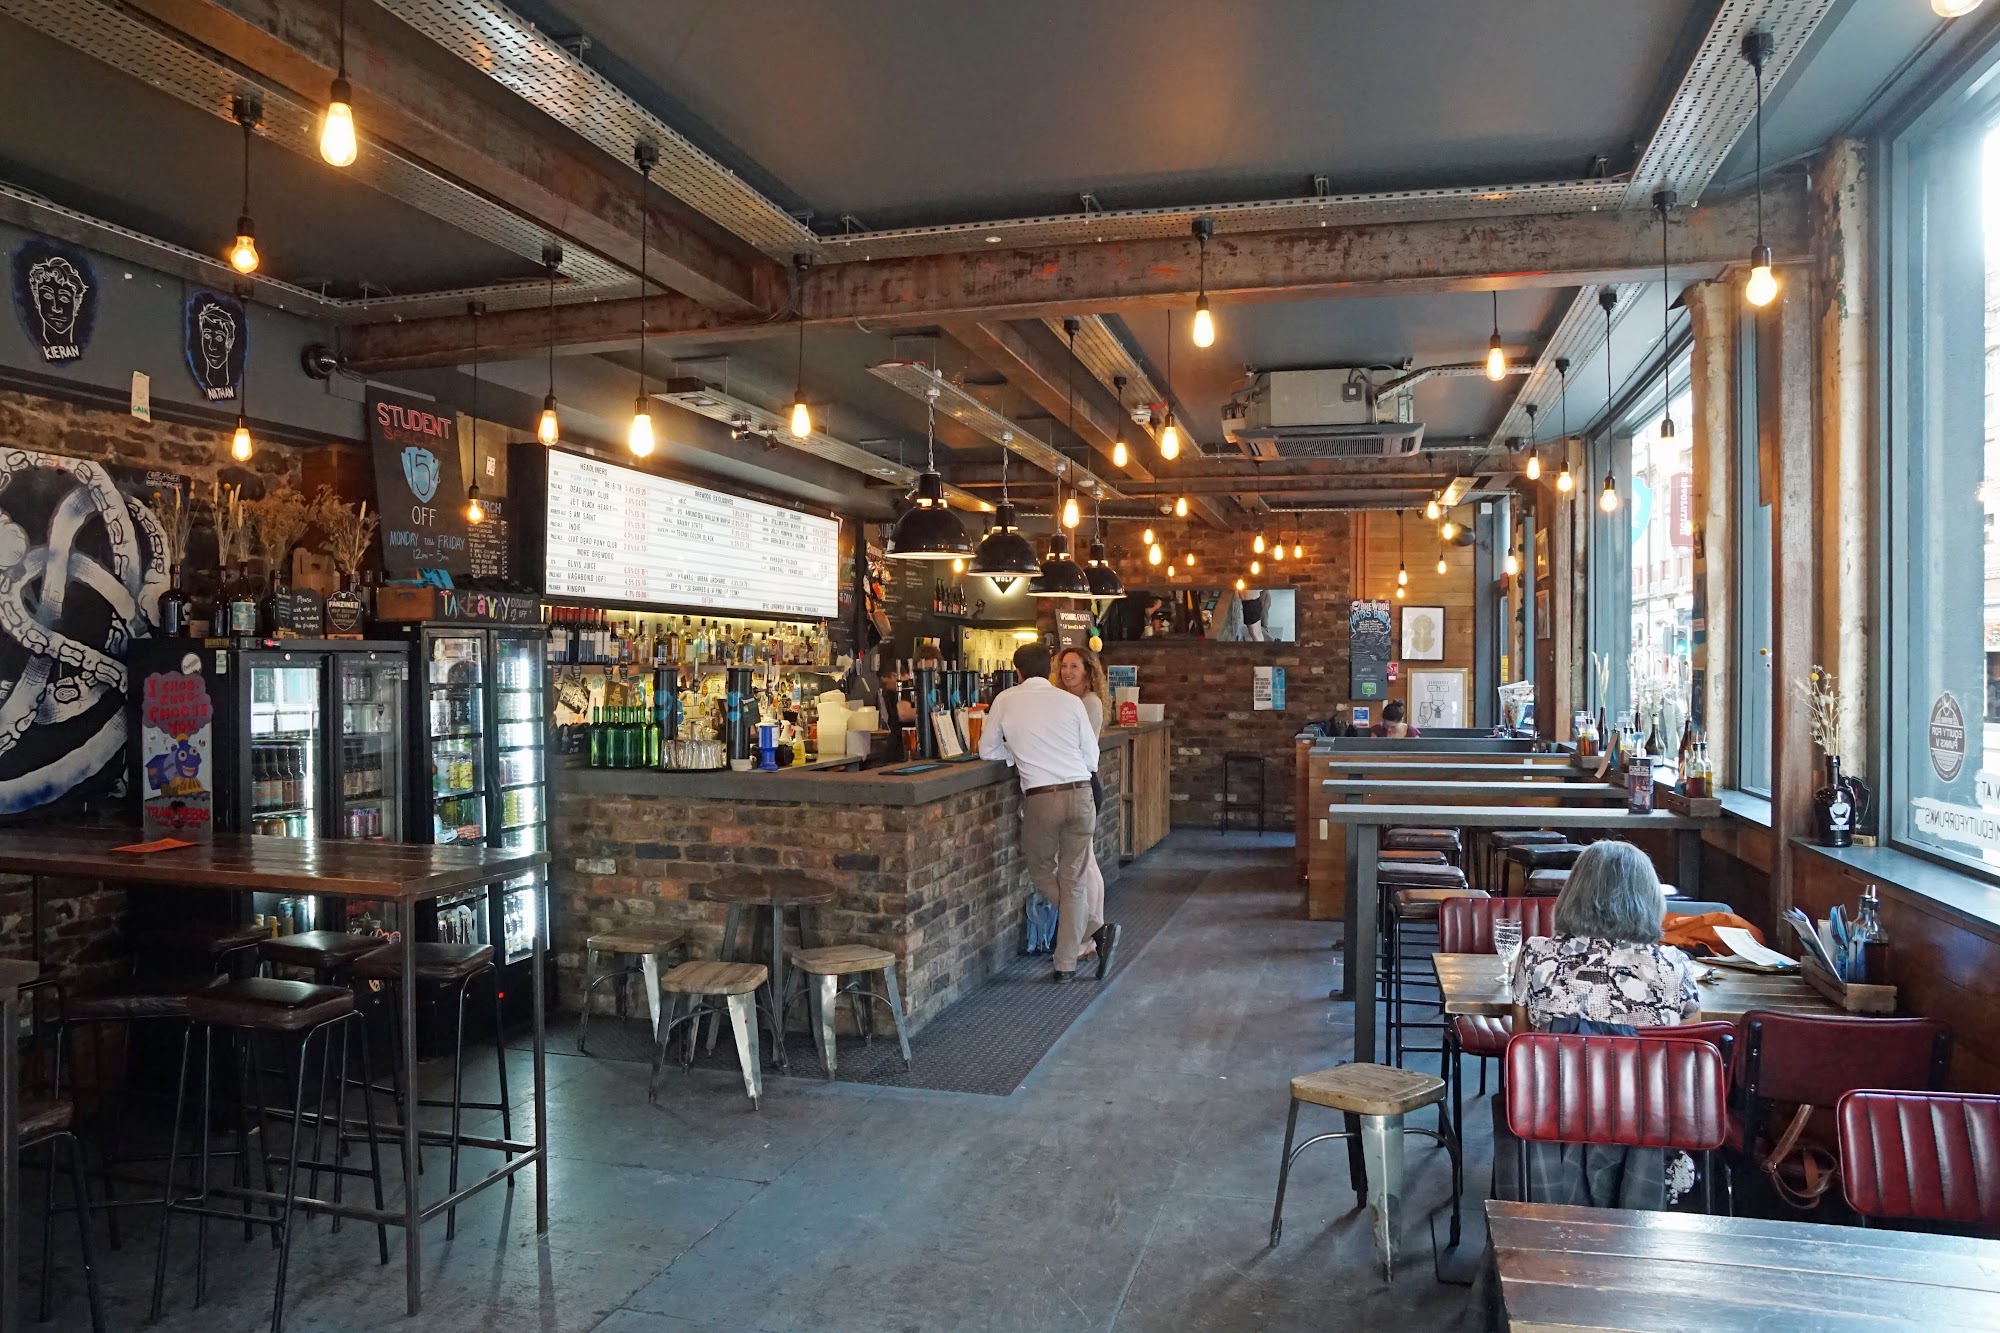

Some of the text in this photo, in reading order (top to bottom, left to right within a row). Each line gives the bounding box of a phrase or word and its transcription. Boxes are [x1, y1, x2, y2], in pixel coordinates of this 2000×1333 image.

[43, 345, 80, 360] KIERAN
[207, 386, 235, 400] NATHAN
[376, 402, 452, 440] STUDENT
[580, 463, 608, 476] HEADLINERS
[570, 484, 582, 495] DEAD
[583, 487, 595, 497] PONY
[597, 490, 609, 500] CLUB
[570, 497, 579, 506] JET
[582, 499, 595, 509] BLACK
[597, 503, 612, 512] HEART
[411, 505, 437, 527] OFF
[574, 511, 581, 519] AM
[582, 512, 597, 522] SAINT
[568, 522, 581, 532] INDIE
[389, 530, 419, 547] MONDAY
[438, 534, 466, 550] FRIDAY
[568, 535, 579, 543] LIVE
[579, 536, 593, 545] DEAD
[593, 538, 605, 547] PONY
[606, 540, 618, 549] CLUB
[576, 548, 615, 560] MORE BREWDOG
[567, 559, 582, 569] ELVIS
[583, 561, 596, 570] JUICE
[567, 572, 594, 582] VAGABOND
[566, 585, 586, 593] KINGPIN
[296, 595, 312, 604] Please
[510, 598, 533, 609] DISCOUNT
[1360, 602, 1390, 611] BREWDOG
[518, 610, 527, 619] OFF
[1077, 613, 1091, 622] EVENTS
[148, 678, 156, 698] I
[148, 703, 208, 723] CHOOSE
[168, 719, 197, 735] YOU
